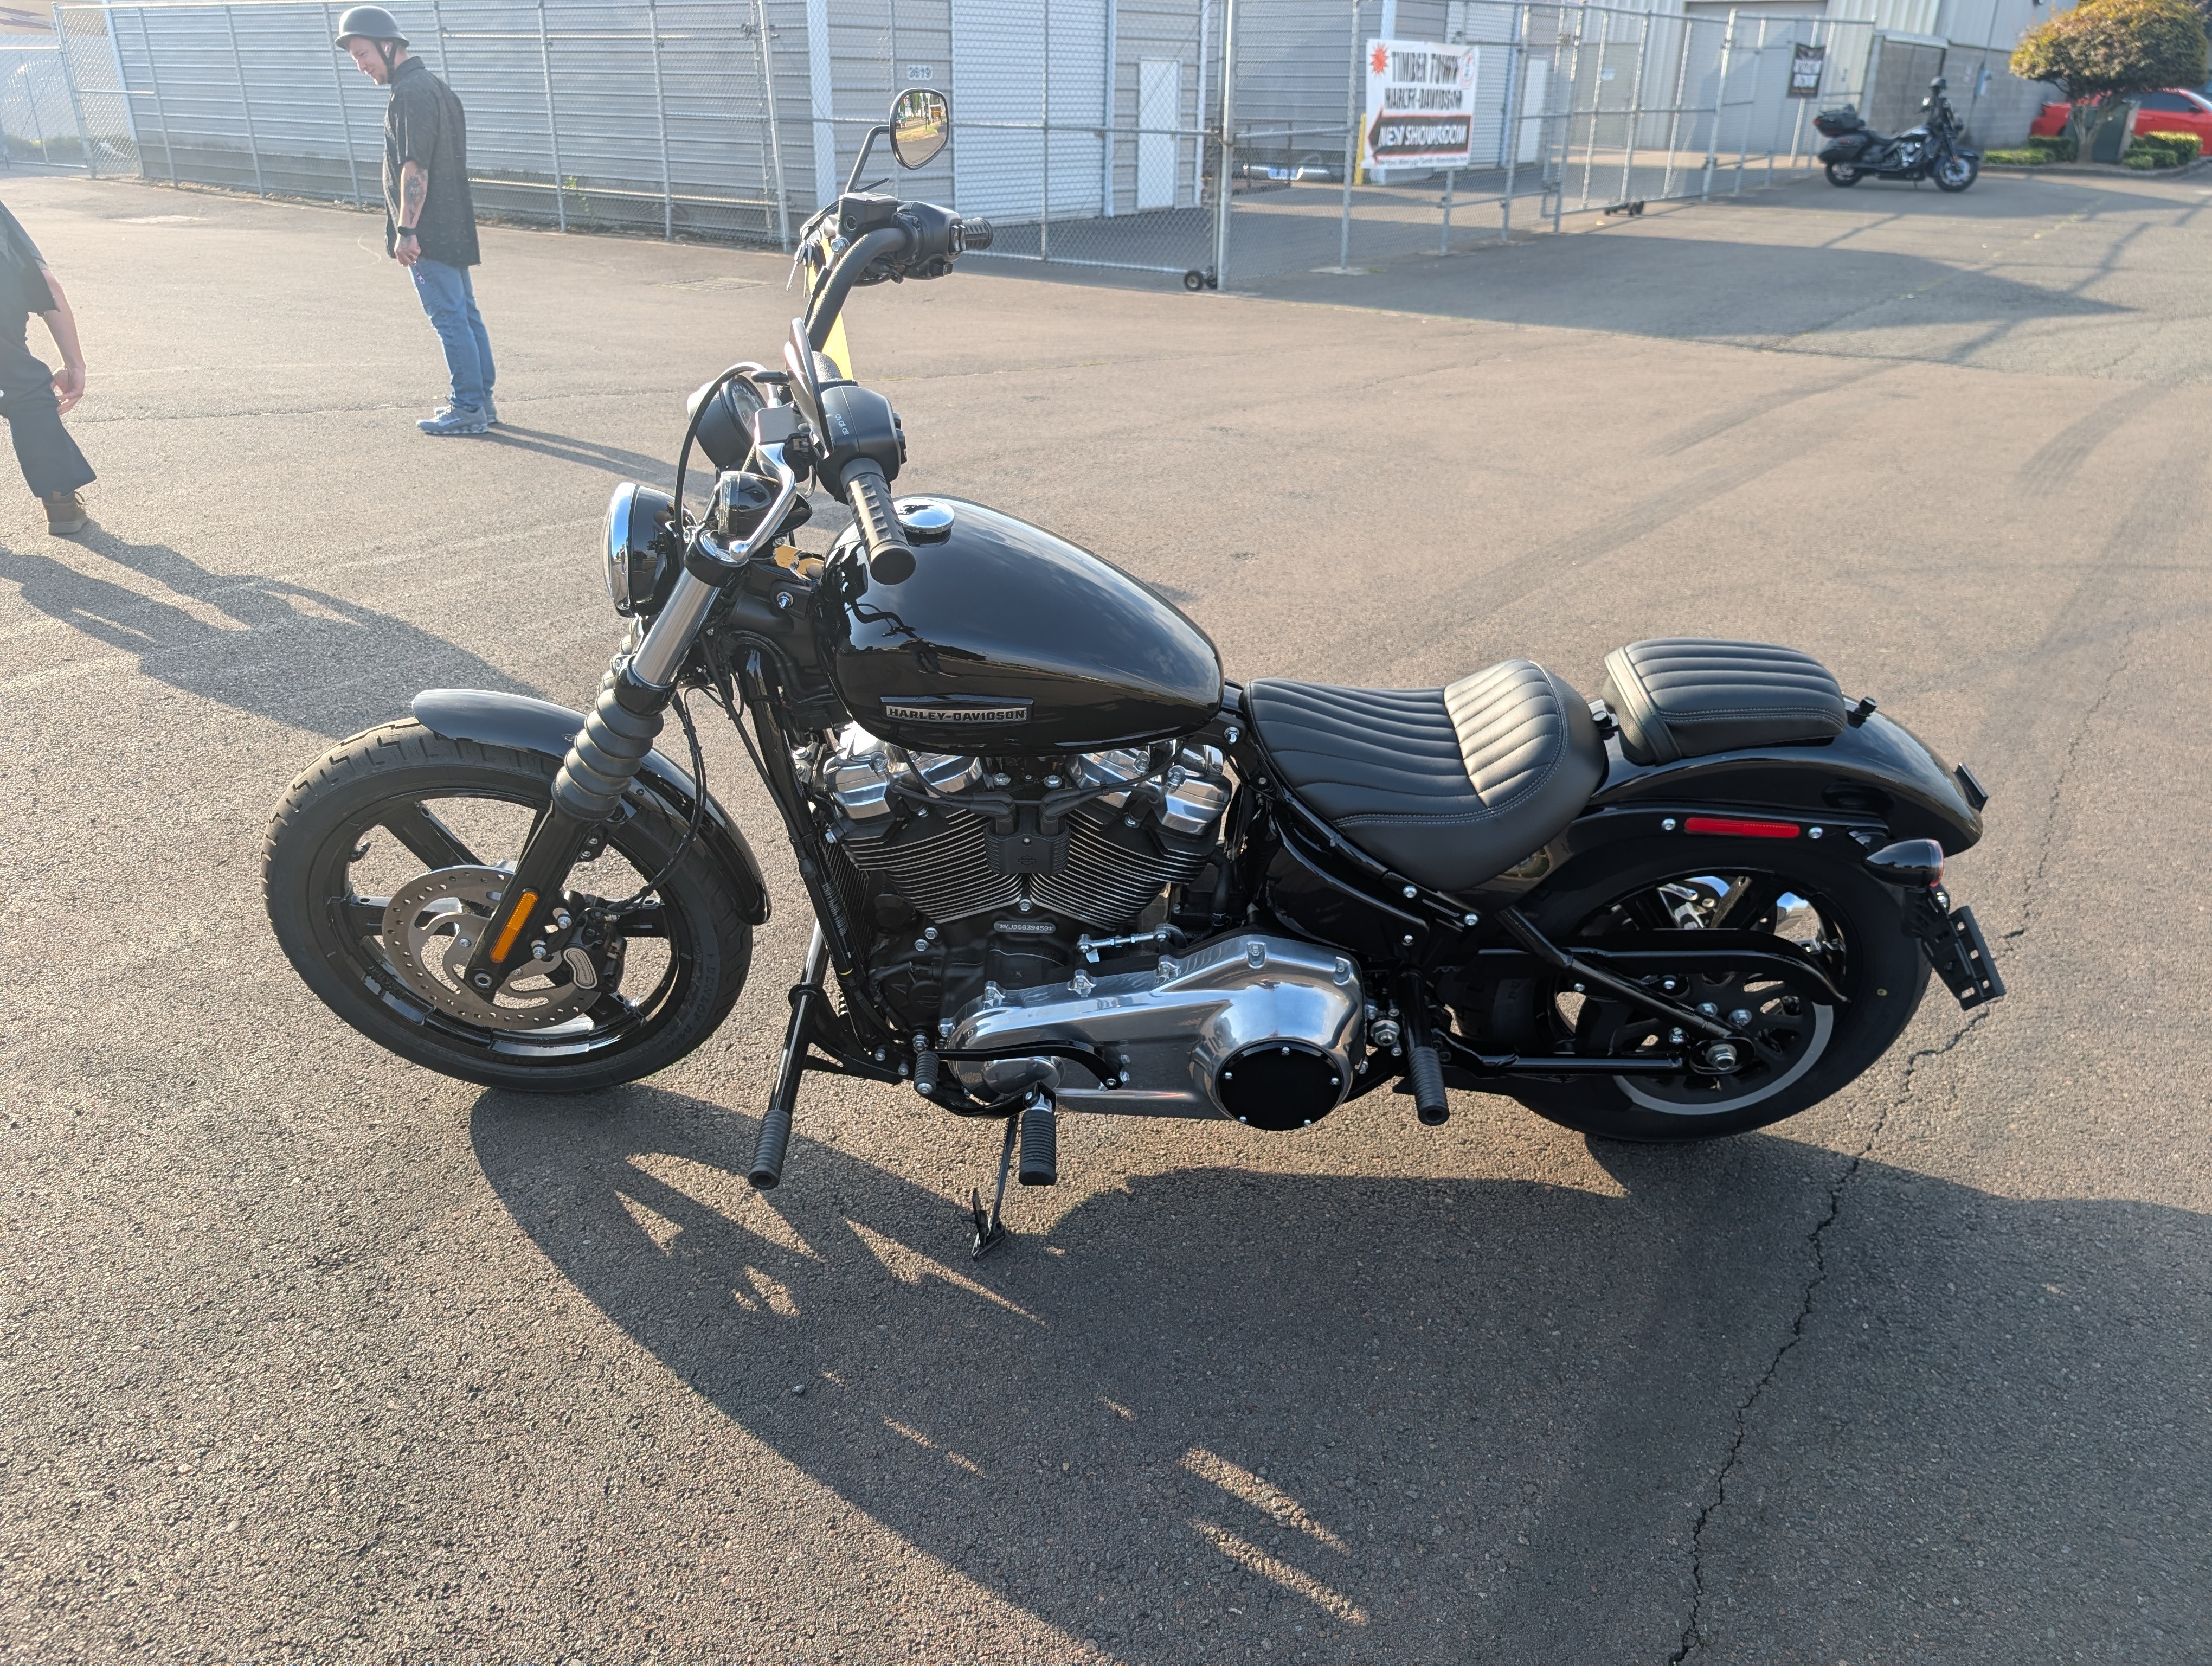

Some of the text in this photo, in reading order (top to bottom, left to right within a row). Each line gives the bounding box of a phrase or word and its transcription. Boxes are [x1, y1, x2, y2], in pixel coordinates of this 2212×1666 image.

[1384, 88, 1462, 109] HARLEY-DAVIDSON
[1378, 125, 1467, 147] NEW SHOWROOM
[889, 708, 1025, 721] HARLEY-DAVIDSON
[693, 965, 716, 1021] DUNLOP
